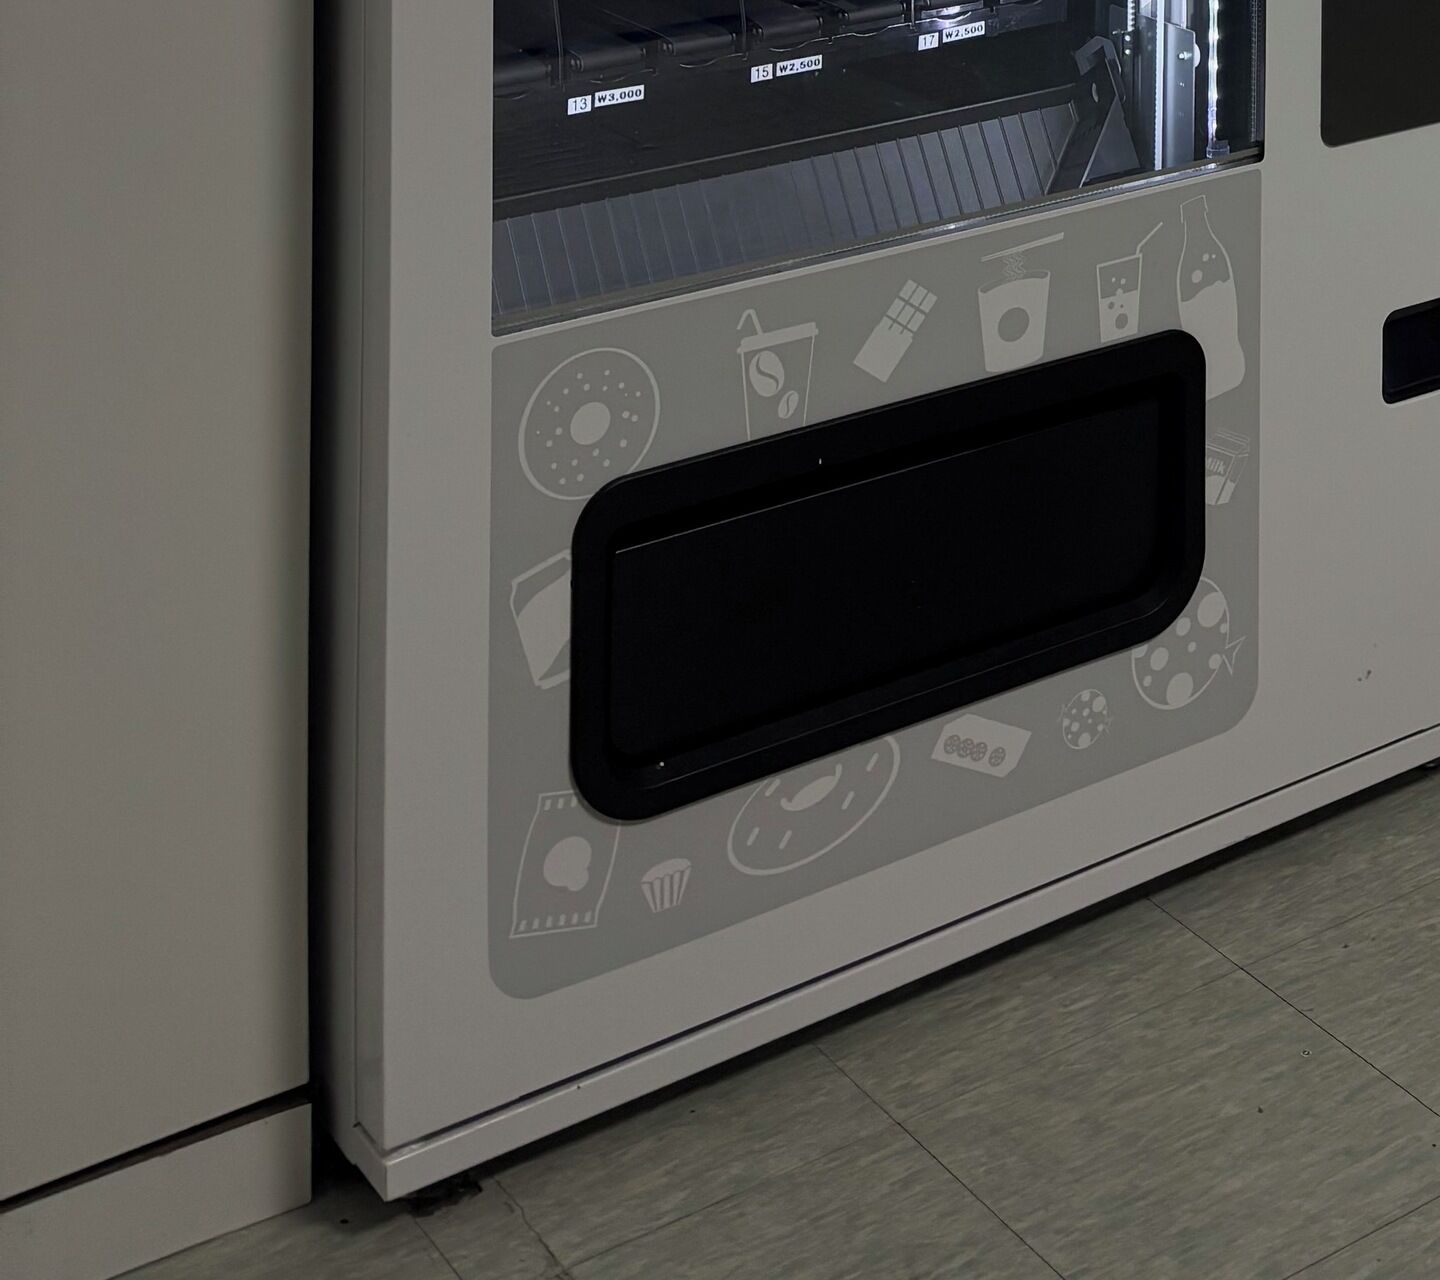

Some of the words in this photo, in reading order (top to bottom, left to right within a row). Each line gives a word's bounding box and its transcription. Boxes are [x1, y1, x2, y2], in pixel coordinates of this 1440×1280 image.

[923, 34, 936, 47] 17
[755, 66, 770, 80] 15
[573, 97, 588, 112] 13
